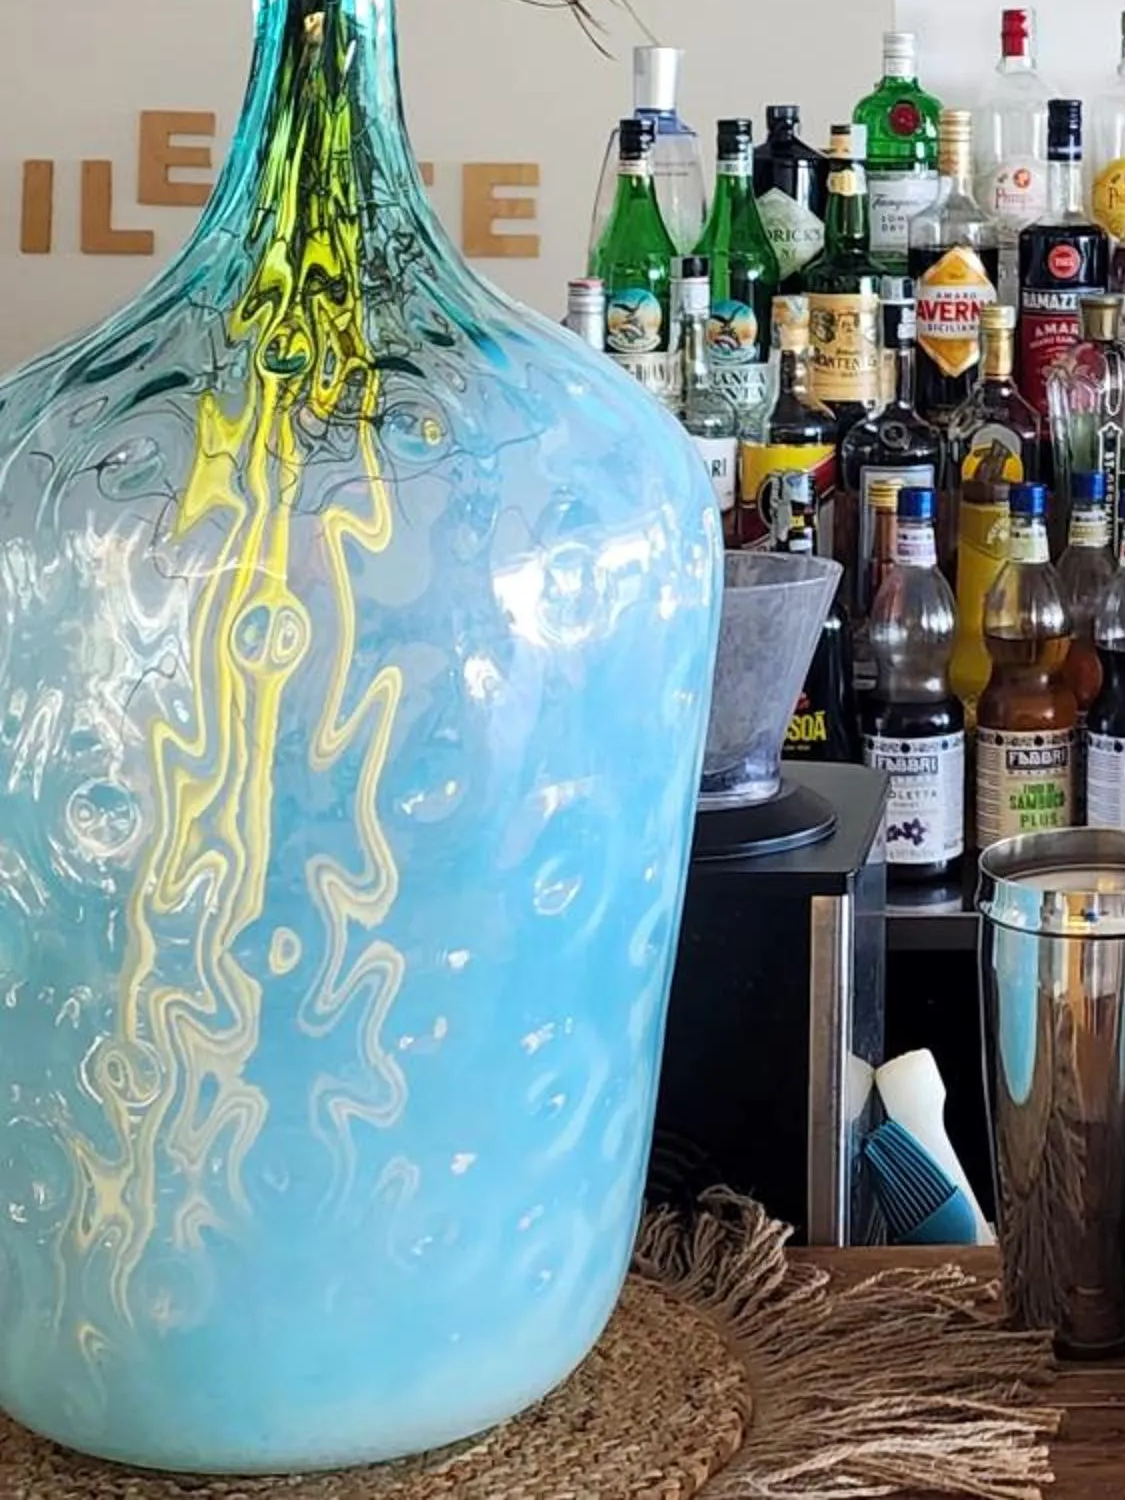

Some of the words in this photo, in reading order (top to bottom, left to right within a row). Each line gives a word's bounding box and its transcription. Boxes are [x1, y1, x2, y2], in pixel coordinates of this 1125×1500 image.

[916, 301, 983, 322] AVERN
[1035, 323, 1080, 336] AMAR
[785, 710, 827, 741] SOÃ
